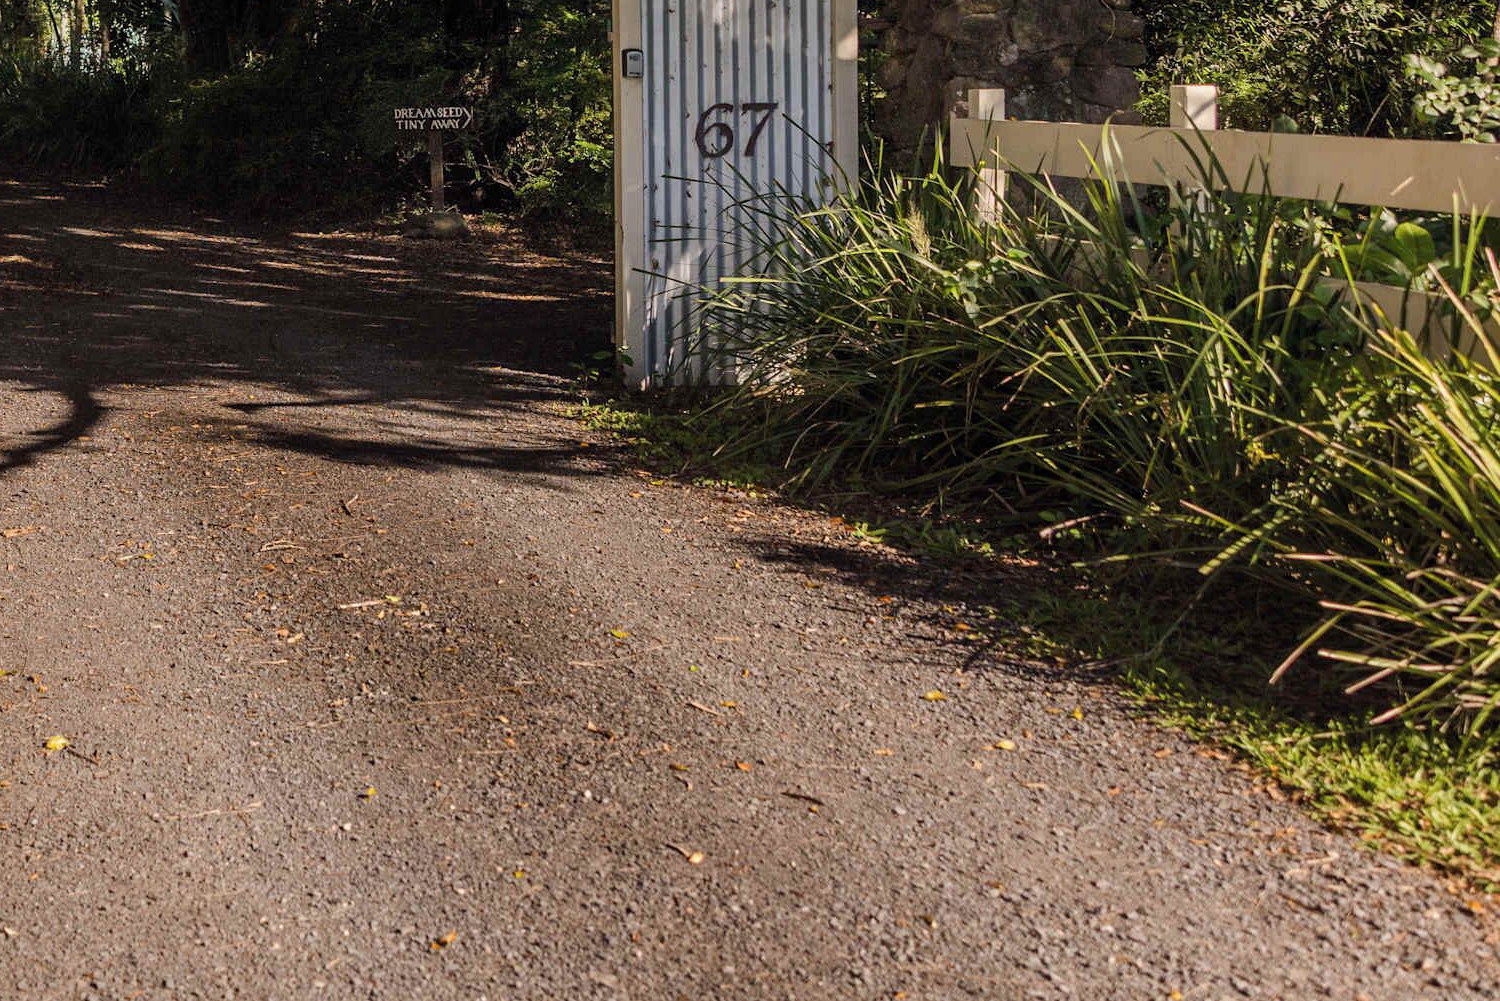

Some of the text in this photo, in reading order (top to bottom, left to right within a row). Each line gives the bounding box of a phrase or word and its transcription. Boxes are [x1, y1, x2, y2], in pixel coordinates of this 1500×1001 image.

[396, 119, 460, 130] TINY AWAY
[695, 103, 778, 158] 67
